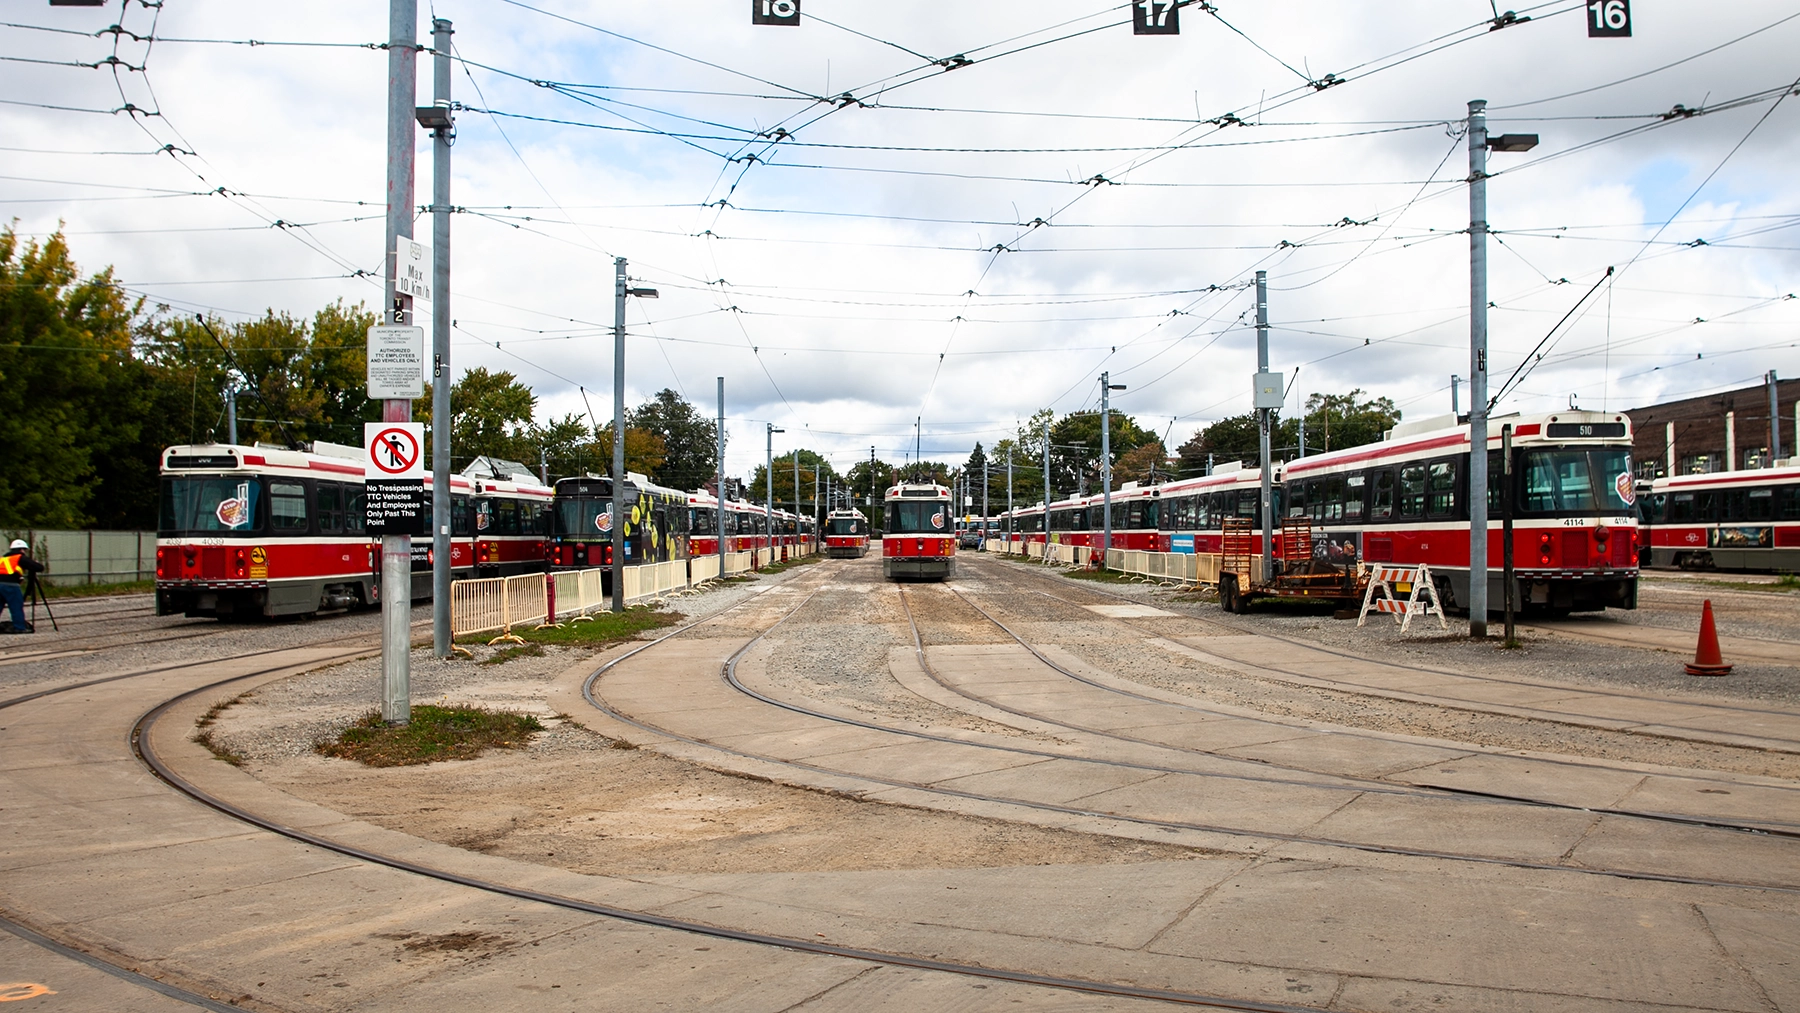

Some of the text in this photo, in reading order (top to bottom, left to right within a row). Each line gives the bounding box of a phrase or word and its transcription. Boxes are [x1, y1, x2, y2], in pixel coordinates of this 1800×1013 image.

[1138, 0, 1175, 27] 17
[1589, 0, 1627, 30] 16
[407, 264, 424, 282] Max
[400, 277, 430, 299] 10 km/h
[1579, 426, 1592, 435] 510
[366, 510, 384, 518] Only
[202, 538, 225, 546] 4039
